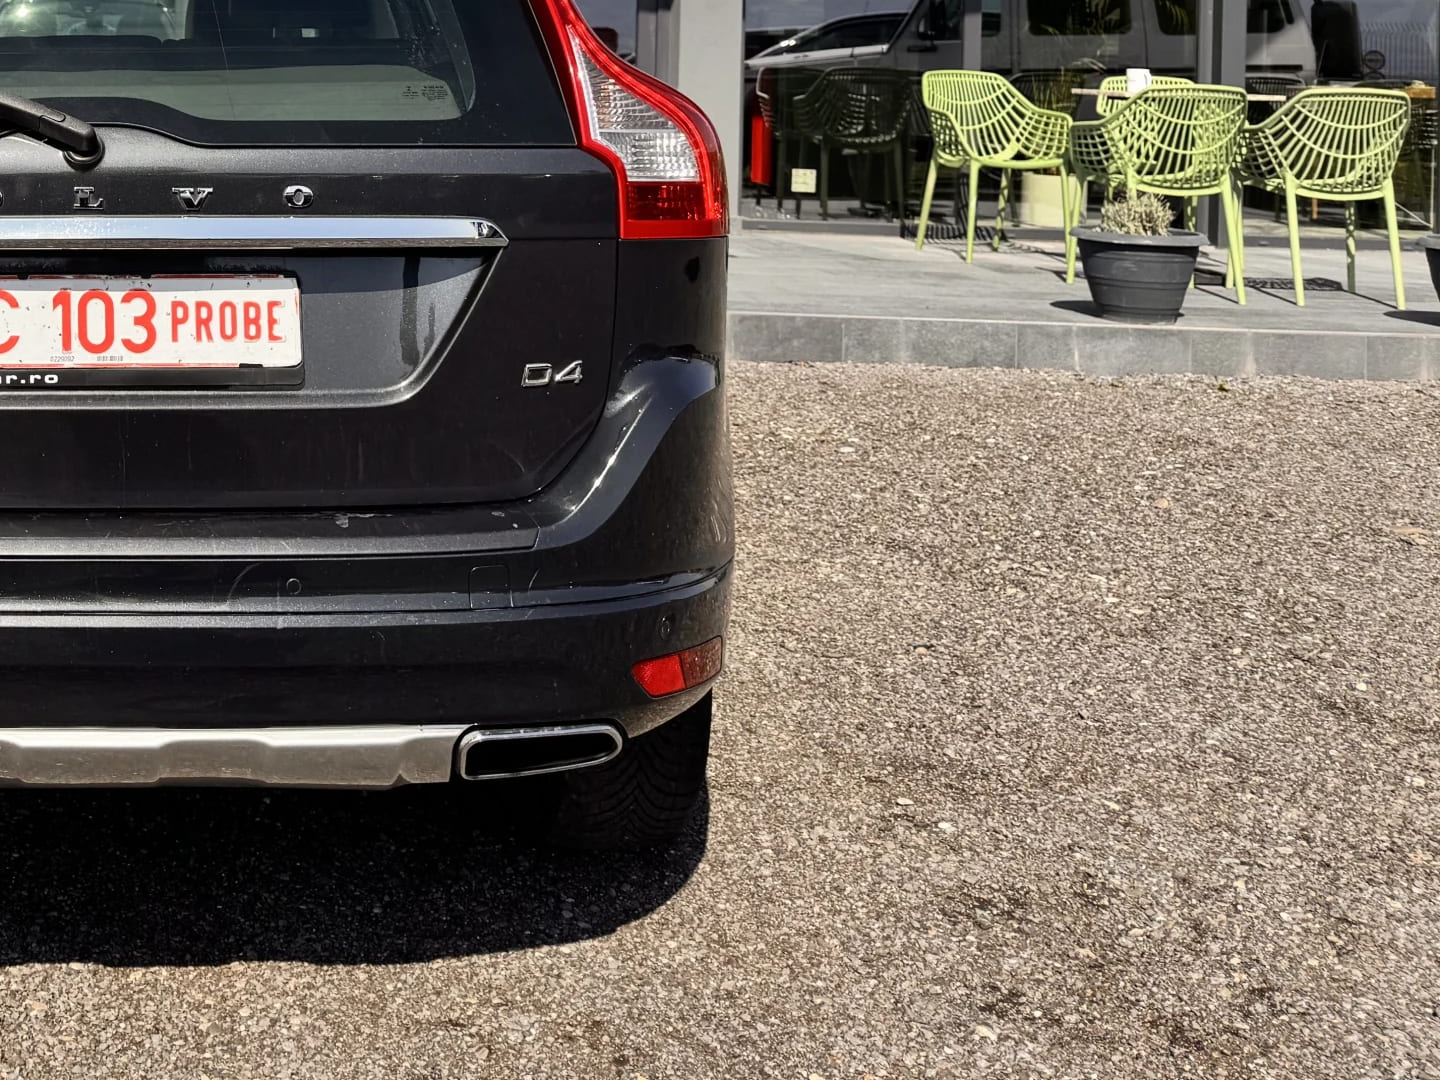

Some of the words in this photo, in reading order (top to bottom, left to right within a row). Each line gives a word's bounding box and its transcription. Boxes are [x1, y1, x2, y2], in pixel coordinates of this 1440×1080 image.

[52, 289, 157, 354] 103
[171, 300, 284, 343] PROBE
[521, 360, 583, 387] D4
